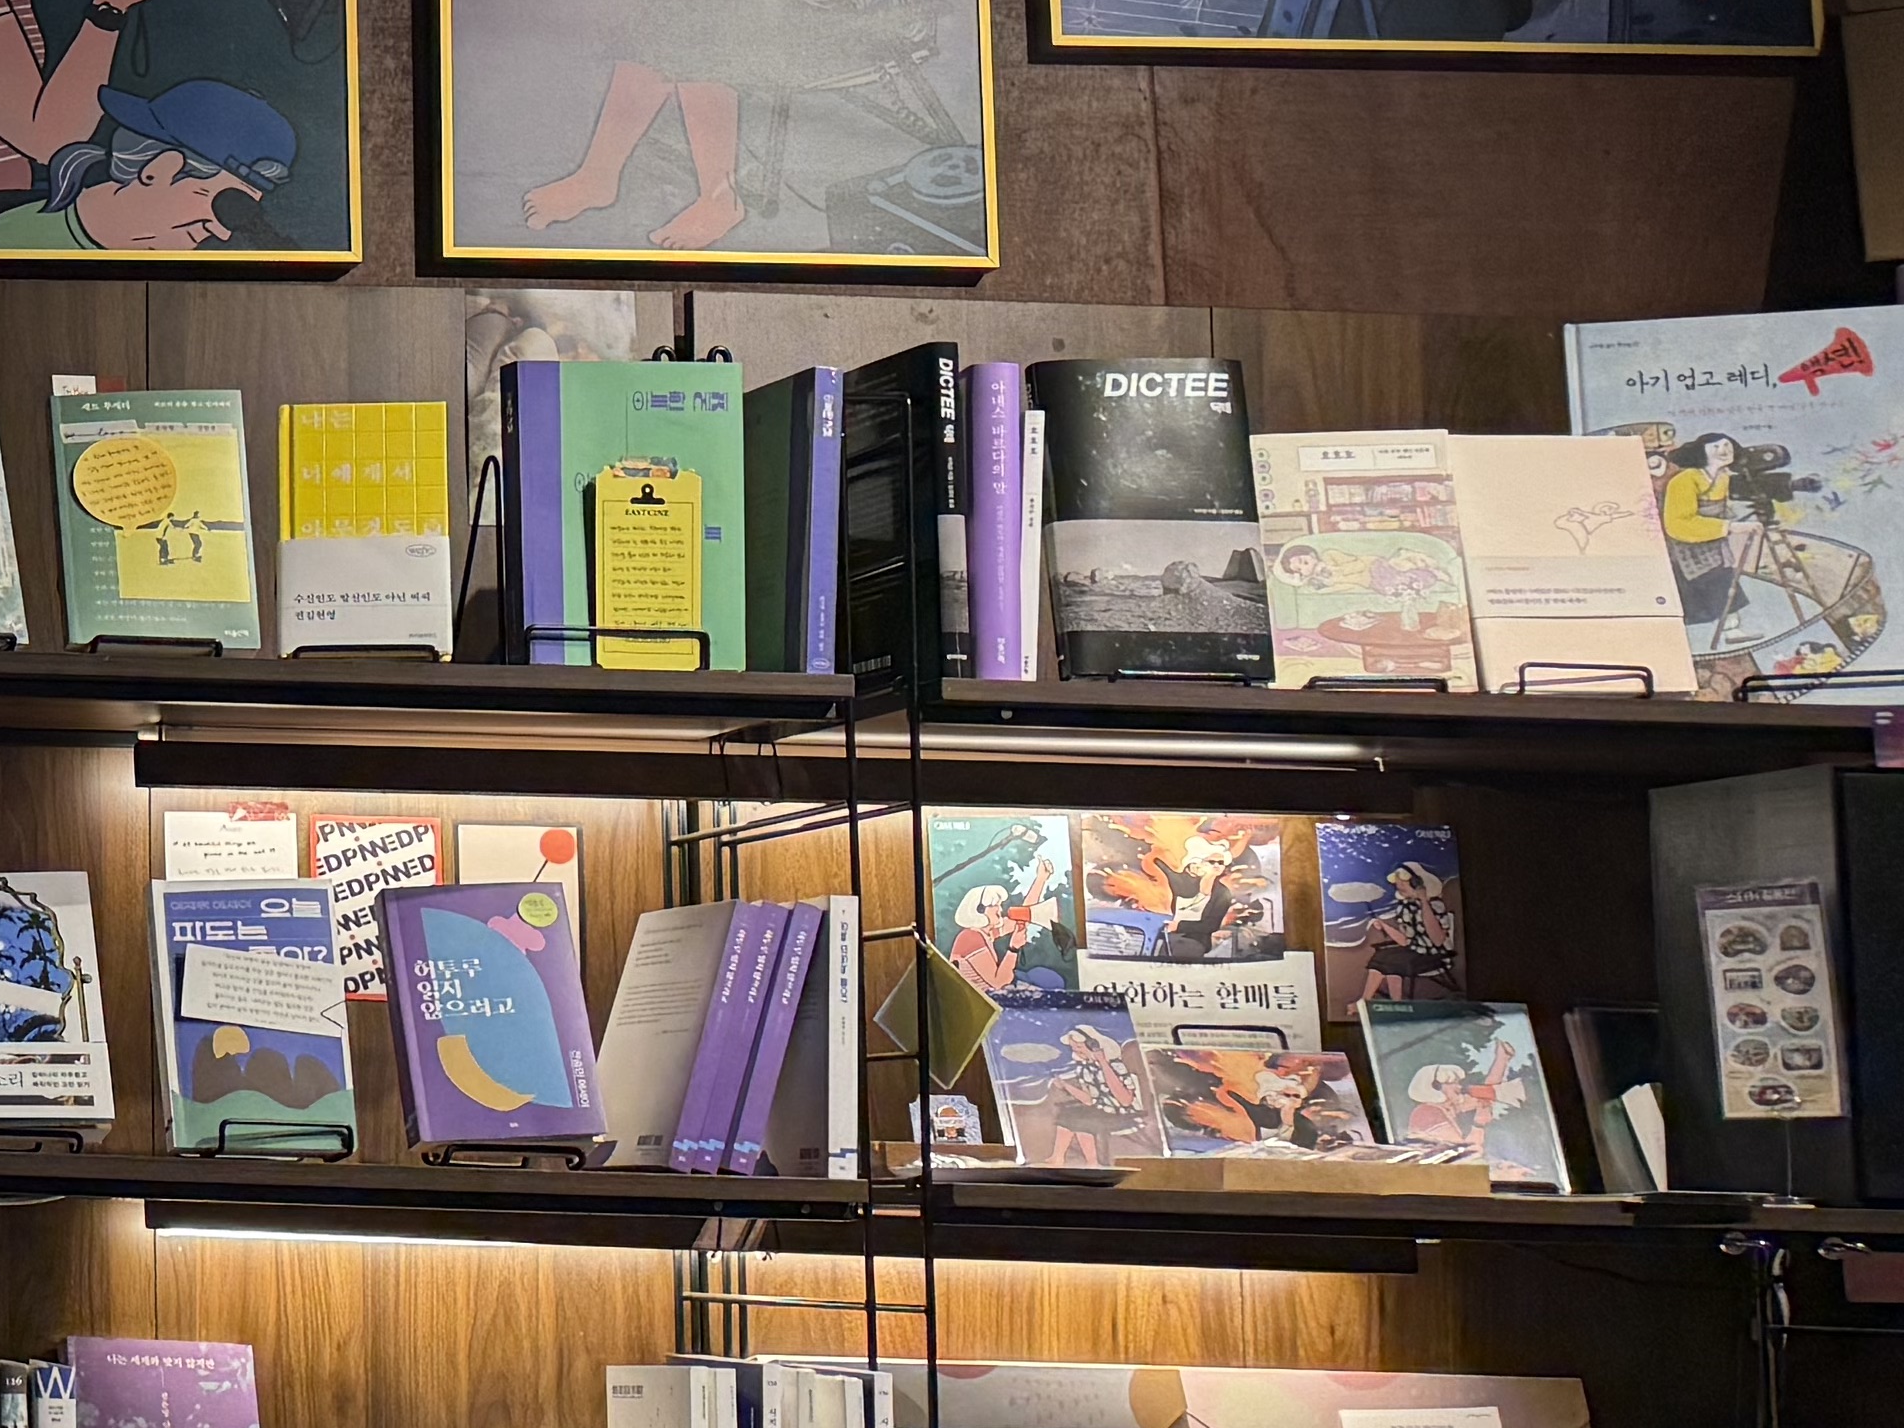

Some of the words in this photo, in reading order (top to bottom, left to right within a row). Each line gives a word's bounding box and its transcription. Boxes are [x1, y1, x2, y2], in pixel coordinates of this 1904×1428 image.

[1625, 369, 1671, 394] 아기
[1676, 367, 1722, 392] 업고
[1725, 364, 1778, 391] 레디,
[1801, 340, 1866, 378] 액션!
[938, 357, 955, 421] DICTEE
[1103, 372, 1230, 397] DICTEE
[259, 895, 322, 919] 오늘
[171, 919, 267, 941] 파도는
[414, 957, 483, 980] 허투루
[416, 979, 462, 1001] 읽지
[1216, 980, 1301, 1010] 할매들
[106, 1354, 127, 1366] 나는
[36, 1366, 75, 1401] W
